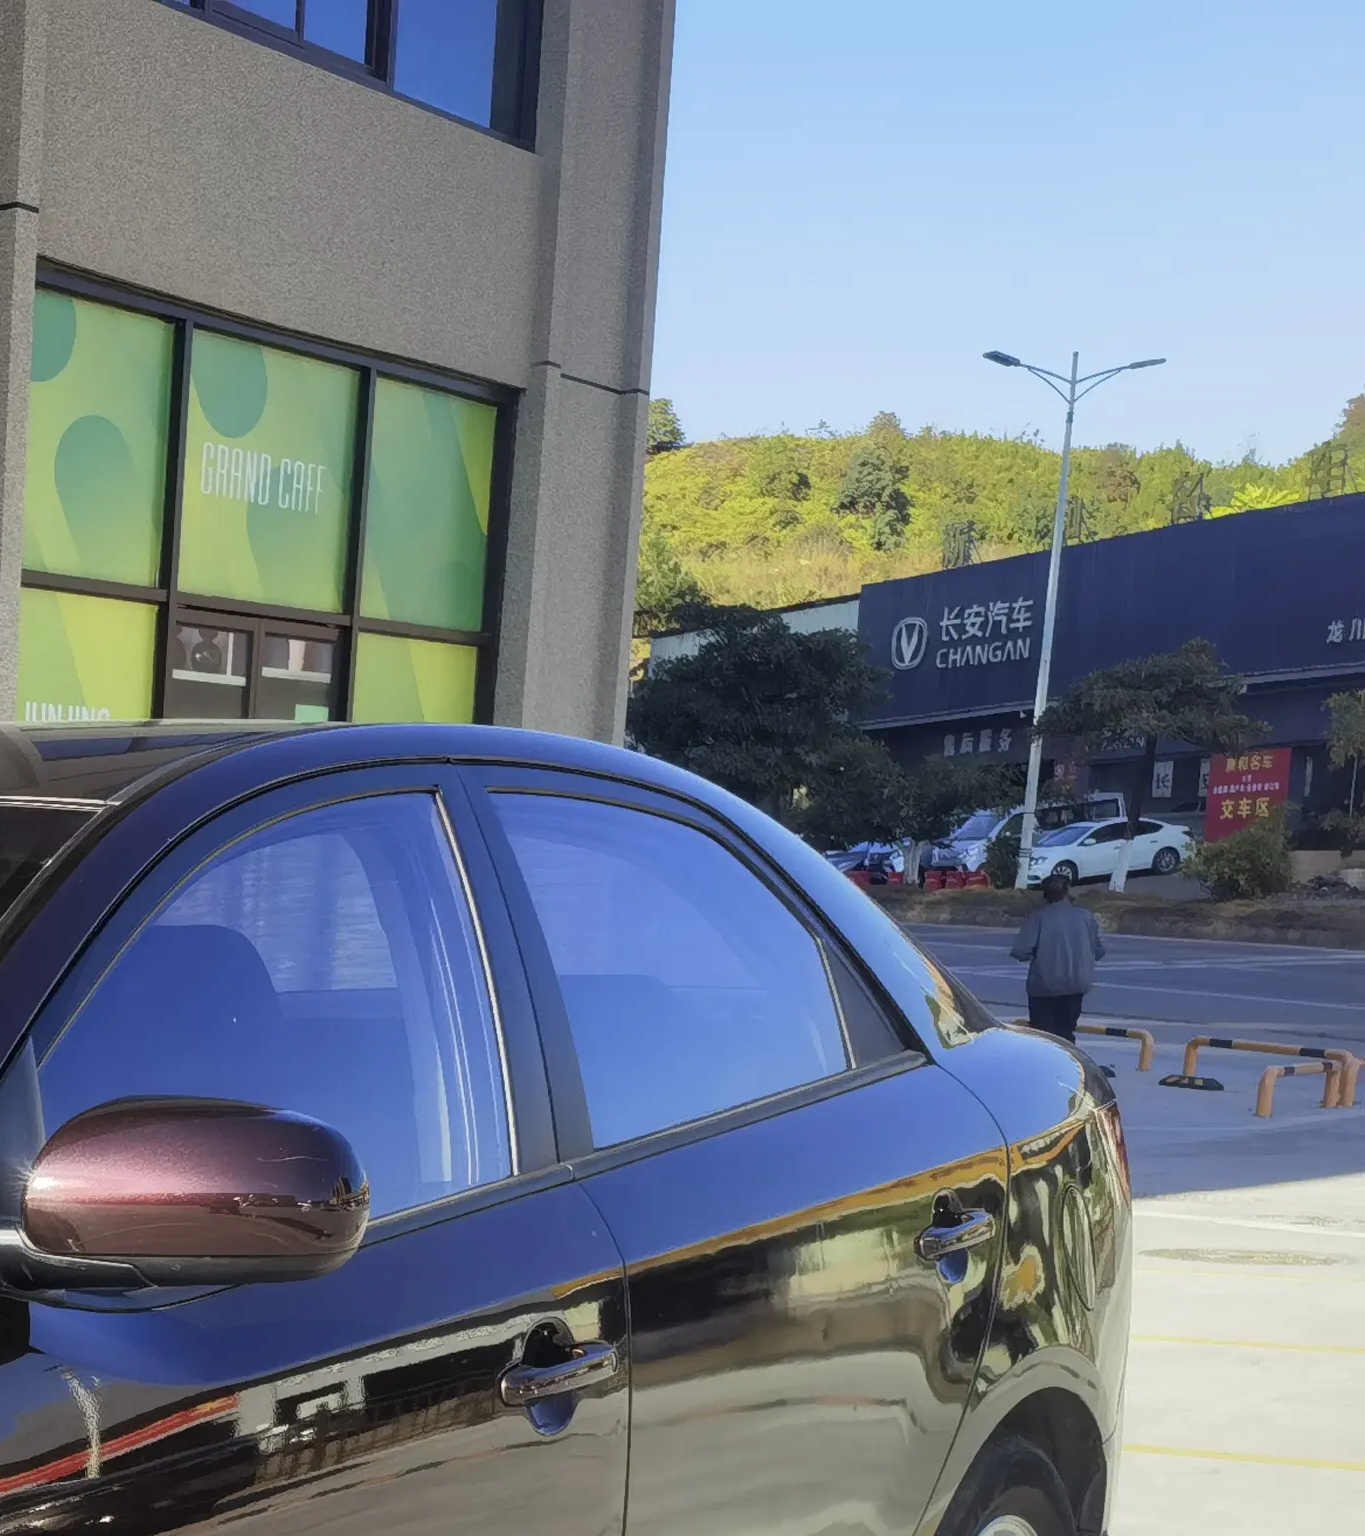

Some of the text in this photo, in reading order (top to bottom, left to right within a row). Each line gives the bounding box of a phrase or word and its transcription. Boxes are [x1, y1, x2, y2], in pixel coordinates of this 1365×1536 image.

[200, 442, 272, 506] GRAND
[939, 596, 1034, 642] 长安汽车
[935, 637, 1031, 669] CHANGAN
[1219, 796, 1271, 820] 交车区
